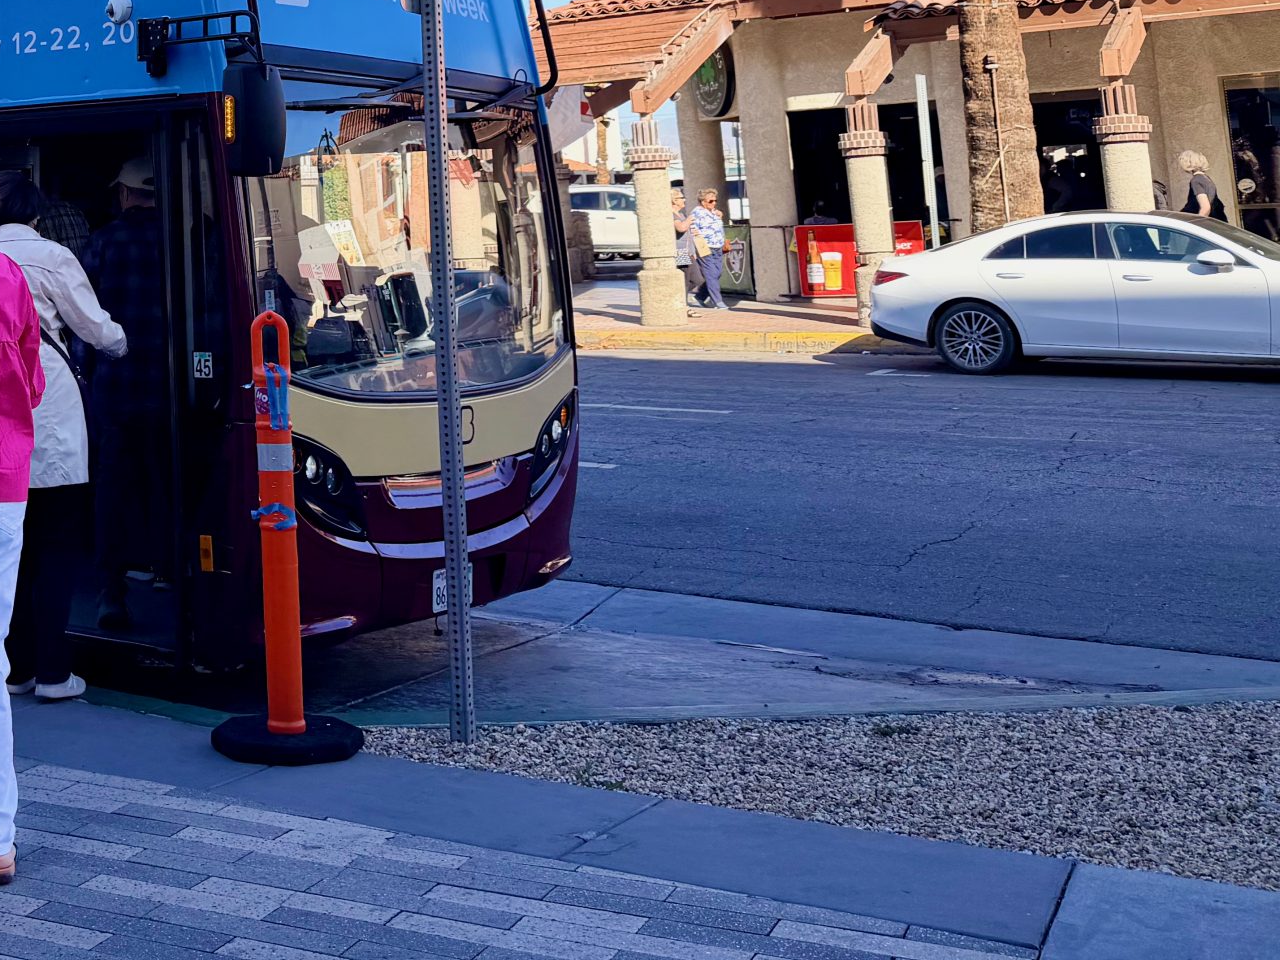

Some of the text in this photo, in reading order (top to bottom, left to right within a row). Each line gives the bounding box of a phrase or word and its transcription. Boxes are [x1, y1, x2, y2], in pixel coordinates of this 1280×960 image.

[11, 25, 90, 55] 12-22,
[102, 20, 135, 46] 20
[895, 242, 912, 250] ser
[195, 358, 211, 377] 45
[256, 391, 269, 402] HO
